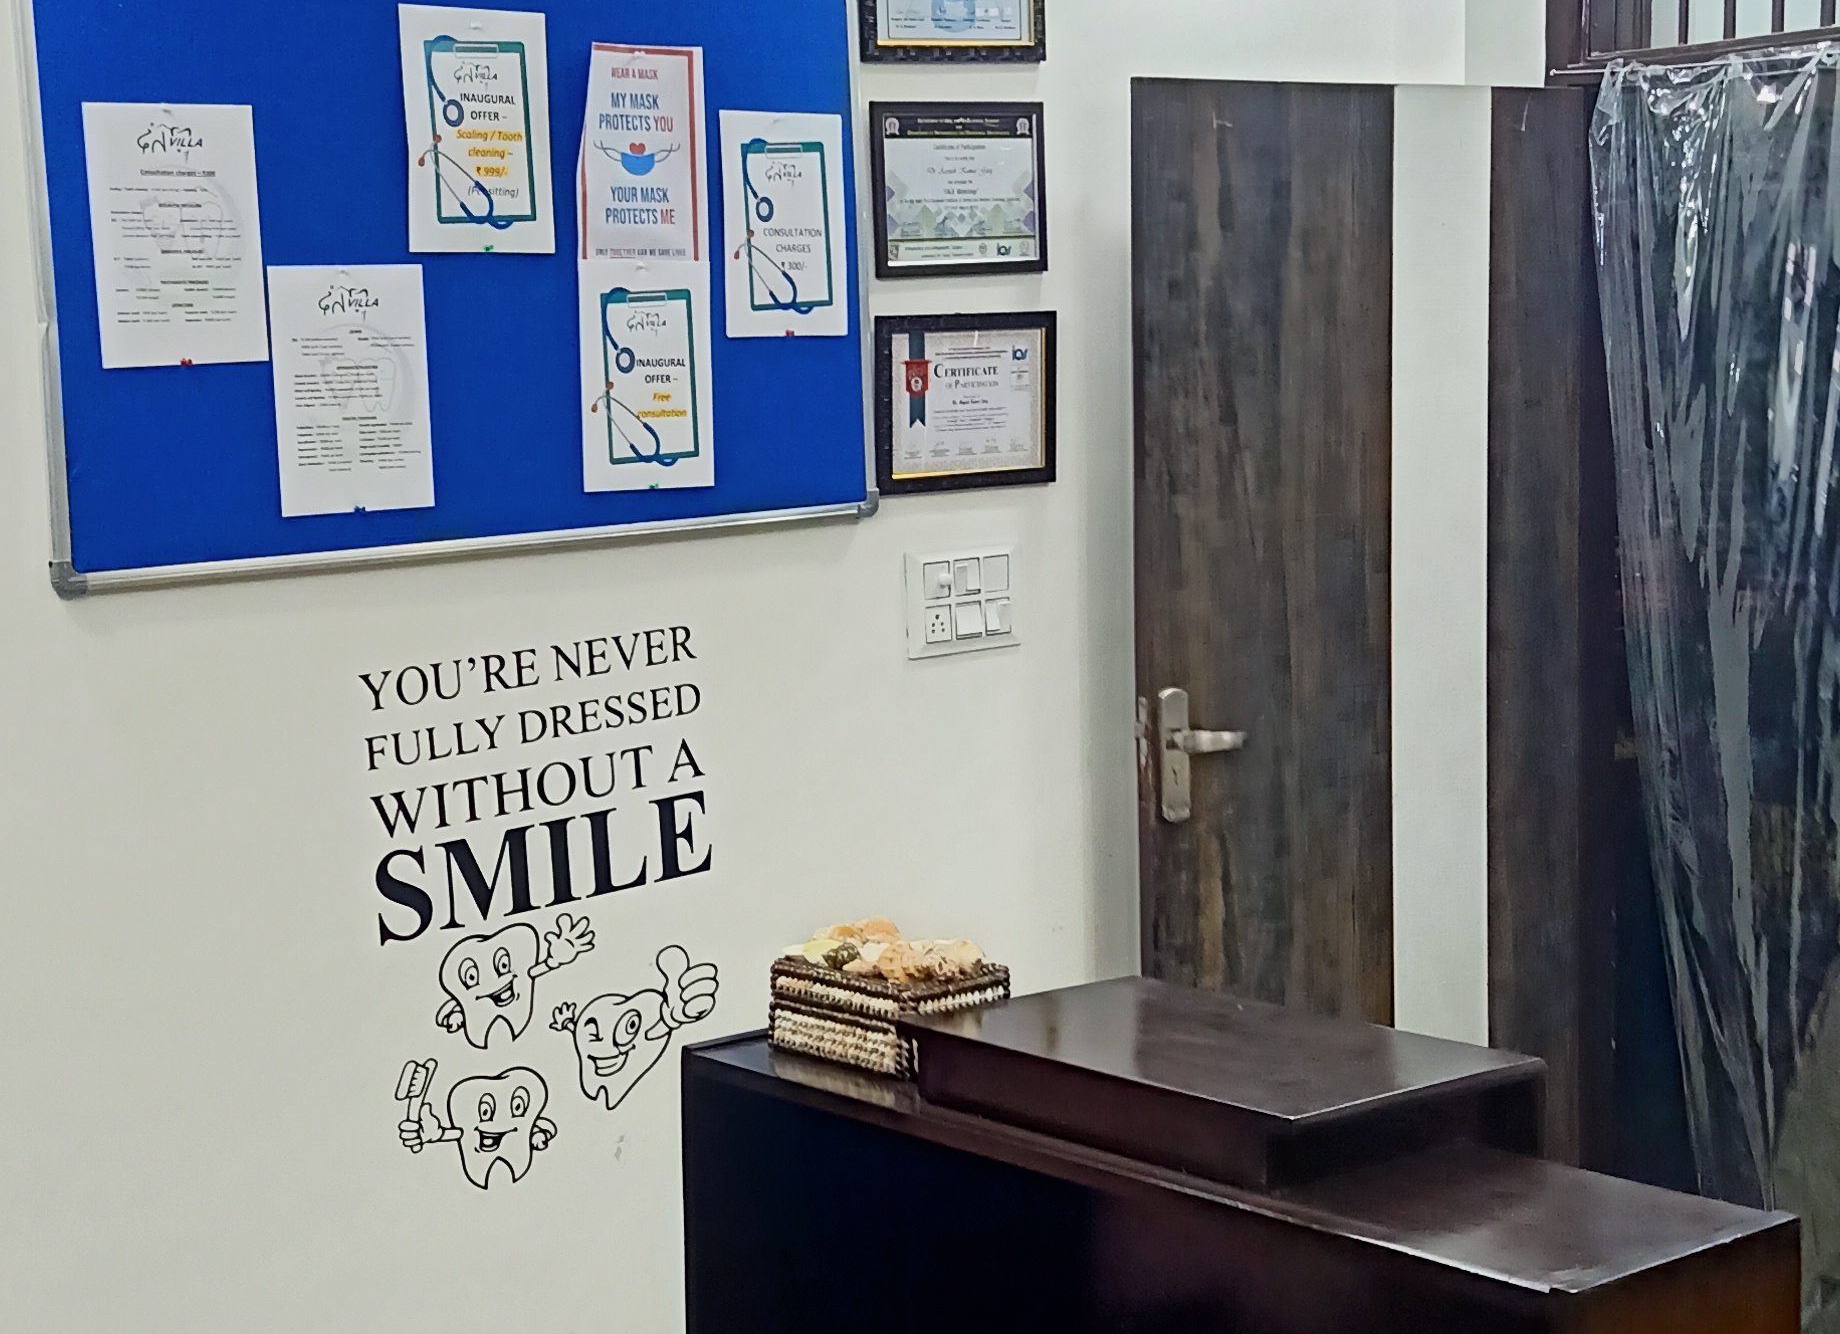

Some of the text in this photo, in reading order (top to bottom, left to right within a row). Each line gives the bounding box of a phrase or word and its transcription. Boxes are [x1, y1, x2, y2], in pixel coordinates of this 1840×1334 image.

[611, 67, 658, 80] WEAR A MASK
[460, 92, 516, 105] INAUGURAL
[611, 92, 659, 109] MY MASK
[470, 110, 500, 121] OFFER
[599, 113, 673, 132] PROTECTS YOU
[170, 137, 202, 147] VILLA
[456, 129, 488, 142] Scaling
[498, 131, 523, 141] Tooth
[468, 147, 506, 160] cleaning
[610, 186, 669, 203] YOUR MASK
[605, 208, 675, 224] PROTECTS ME
[763, 228, 822, 238] CONSULTATION
[775, 244, 811, 253] CHARGES
[348, 298, 379, 308] VILLA
[636, 358, 686, 367] INAUGURAL
[645, 374, 671, 383] OFFER
[653, 393, 672, 402] Free
[637, 409, 687, 418] consultation
[358, 625, 698, 711] YOU'RE NEVER
[364, 683, 701, 772] FULLY DRESSED
[370, 737, 706, 839] WITHOUT A
[375, 790, 713, 947] SMILE
